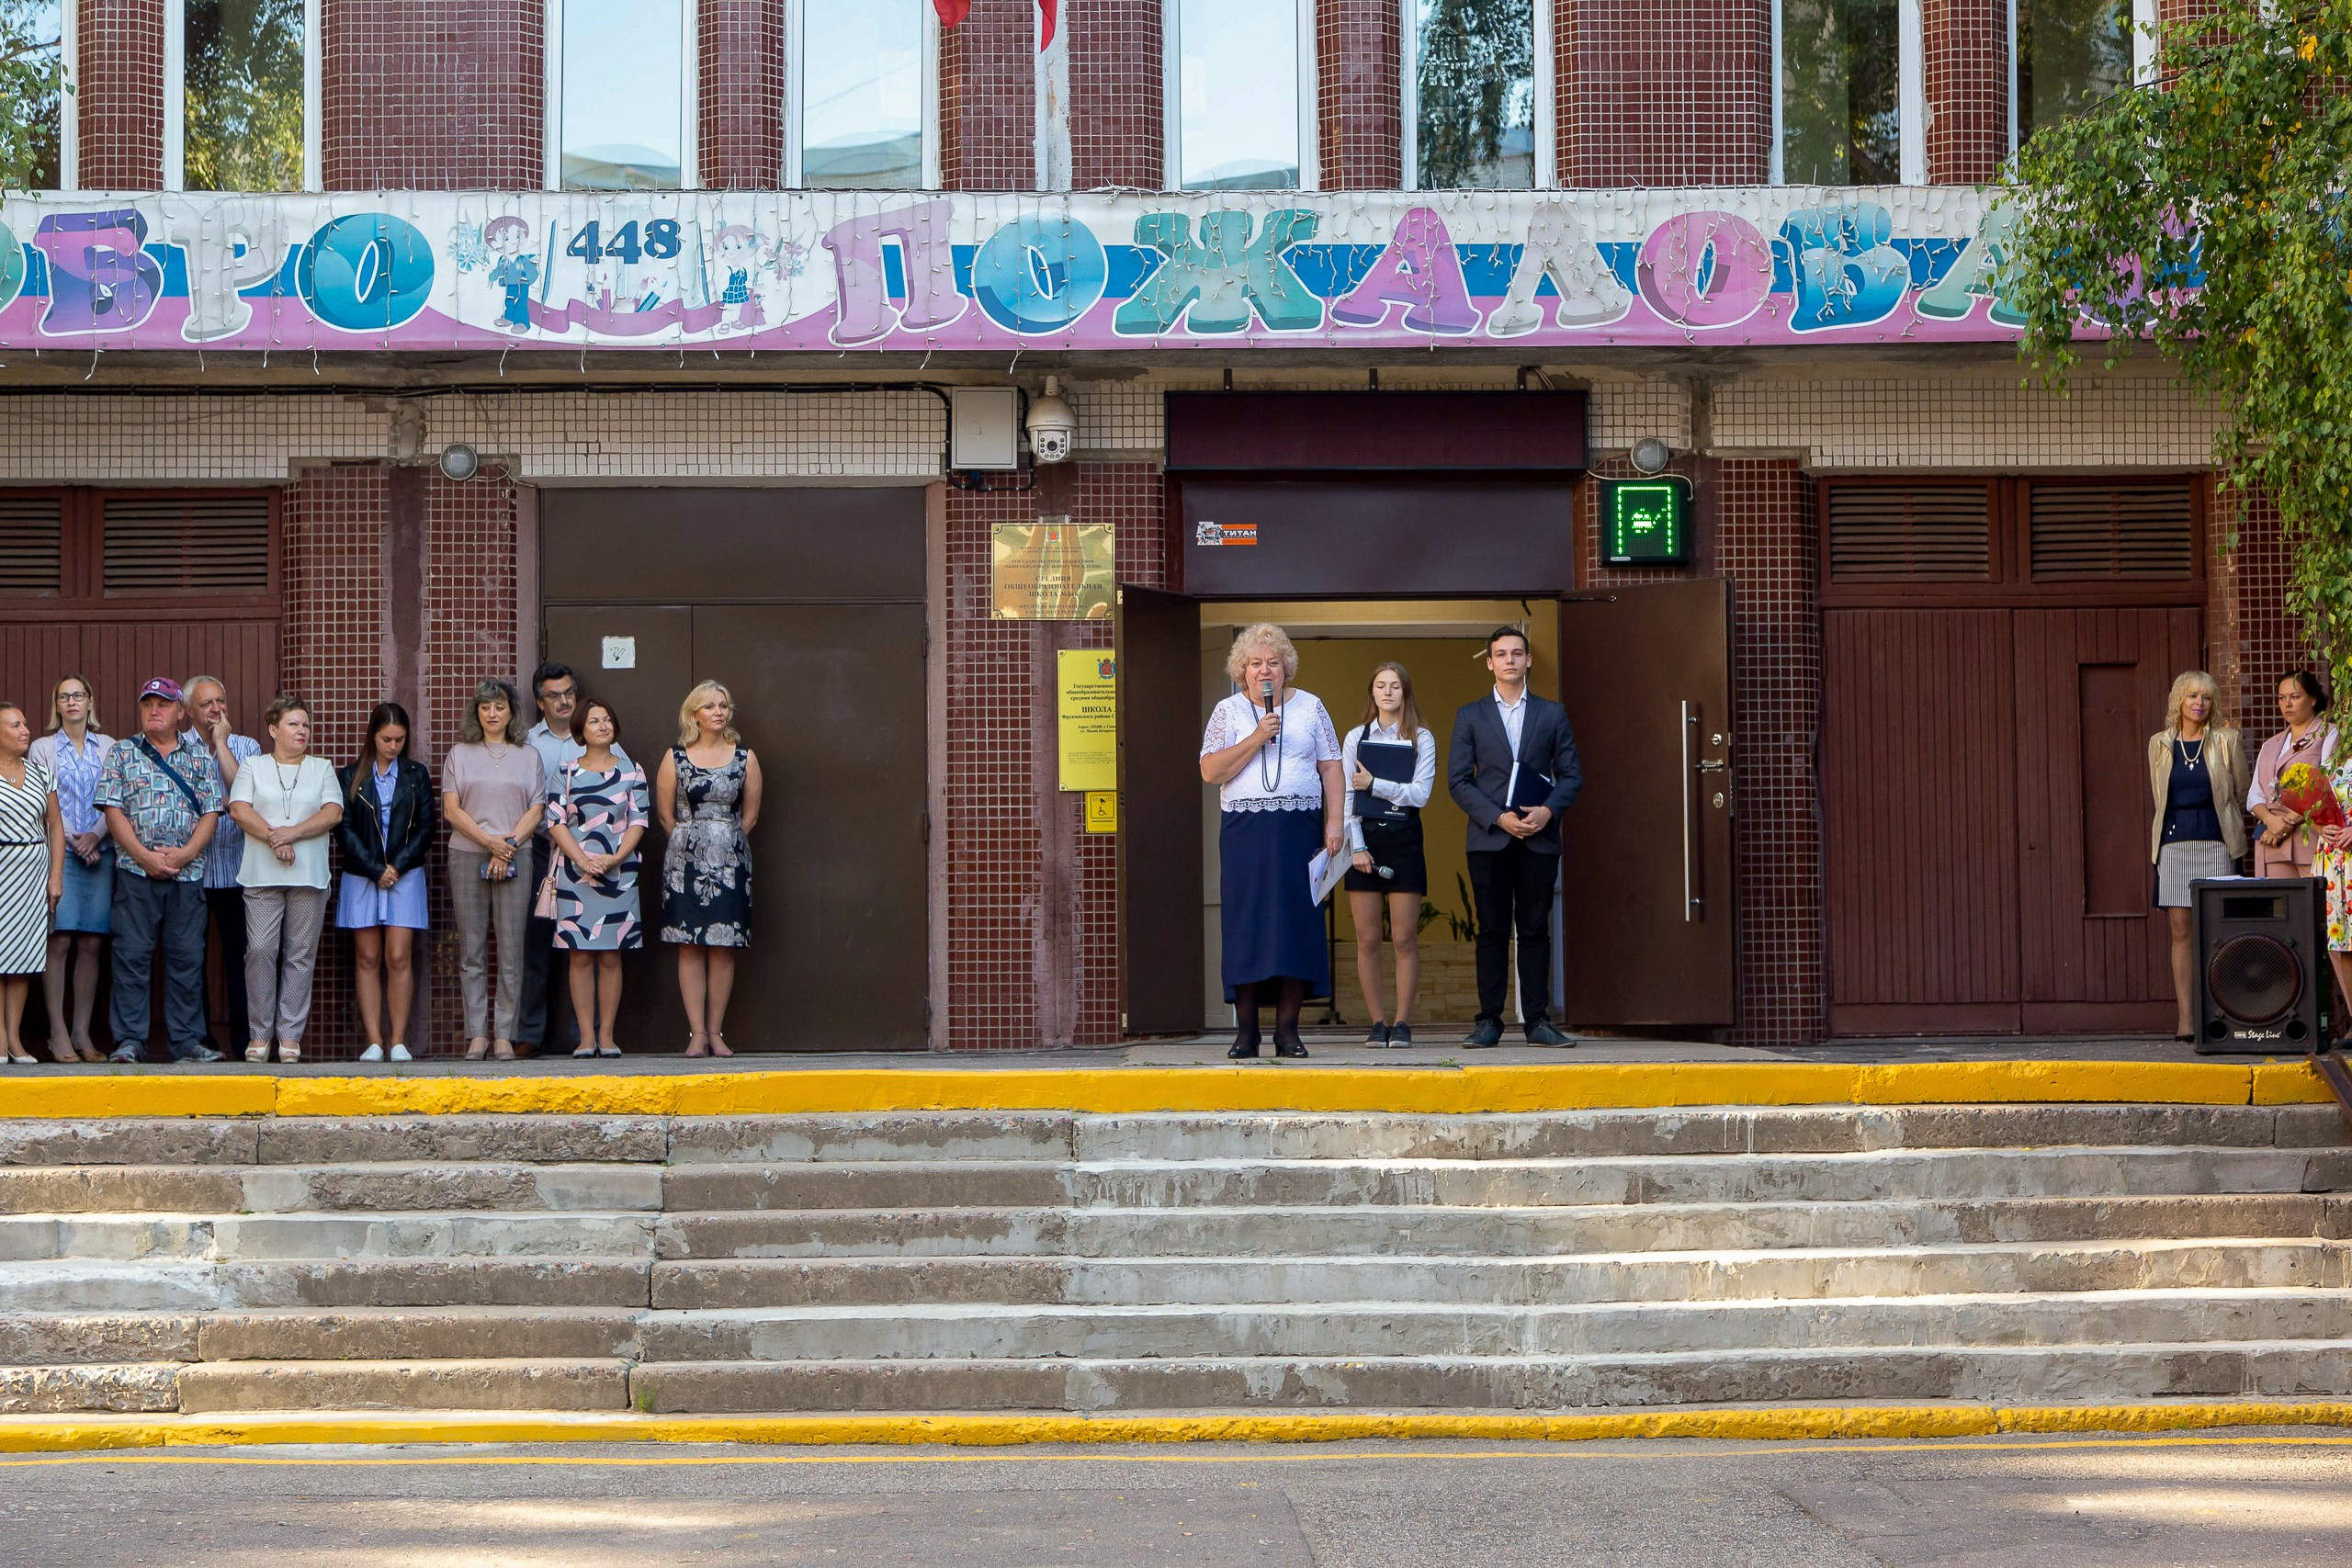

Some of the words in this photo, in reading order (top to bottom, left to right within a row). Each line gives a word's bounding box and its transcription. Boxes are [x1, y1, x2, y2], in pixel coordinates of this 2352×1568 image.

[567, 219, 681, 264] 448
[0, 202, 435, 343] БРО
[152, 681, 161, 690] 3
[2247, 1030, 2265, 1042] Stage
[2266, 1030, 2280, 1039] Line
